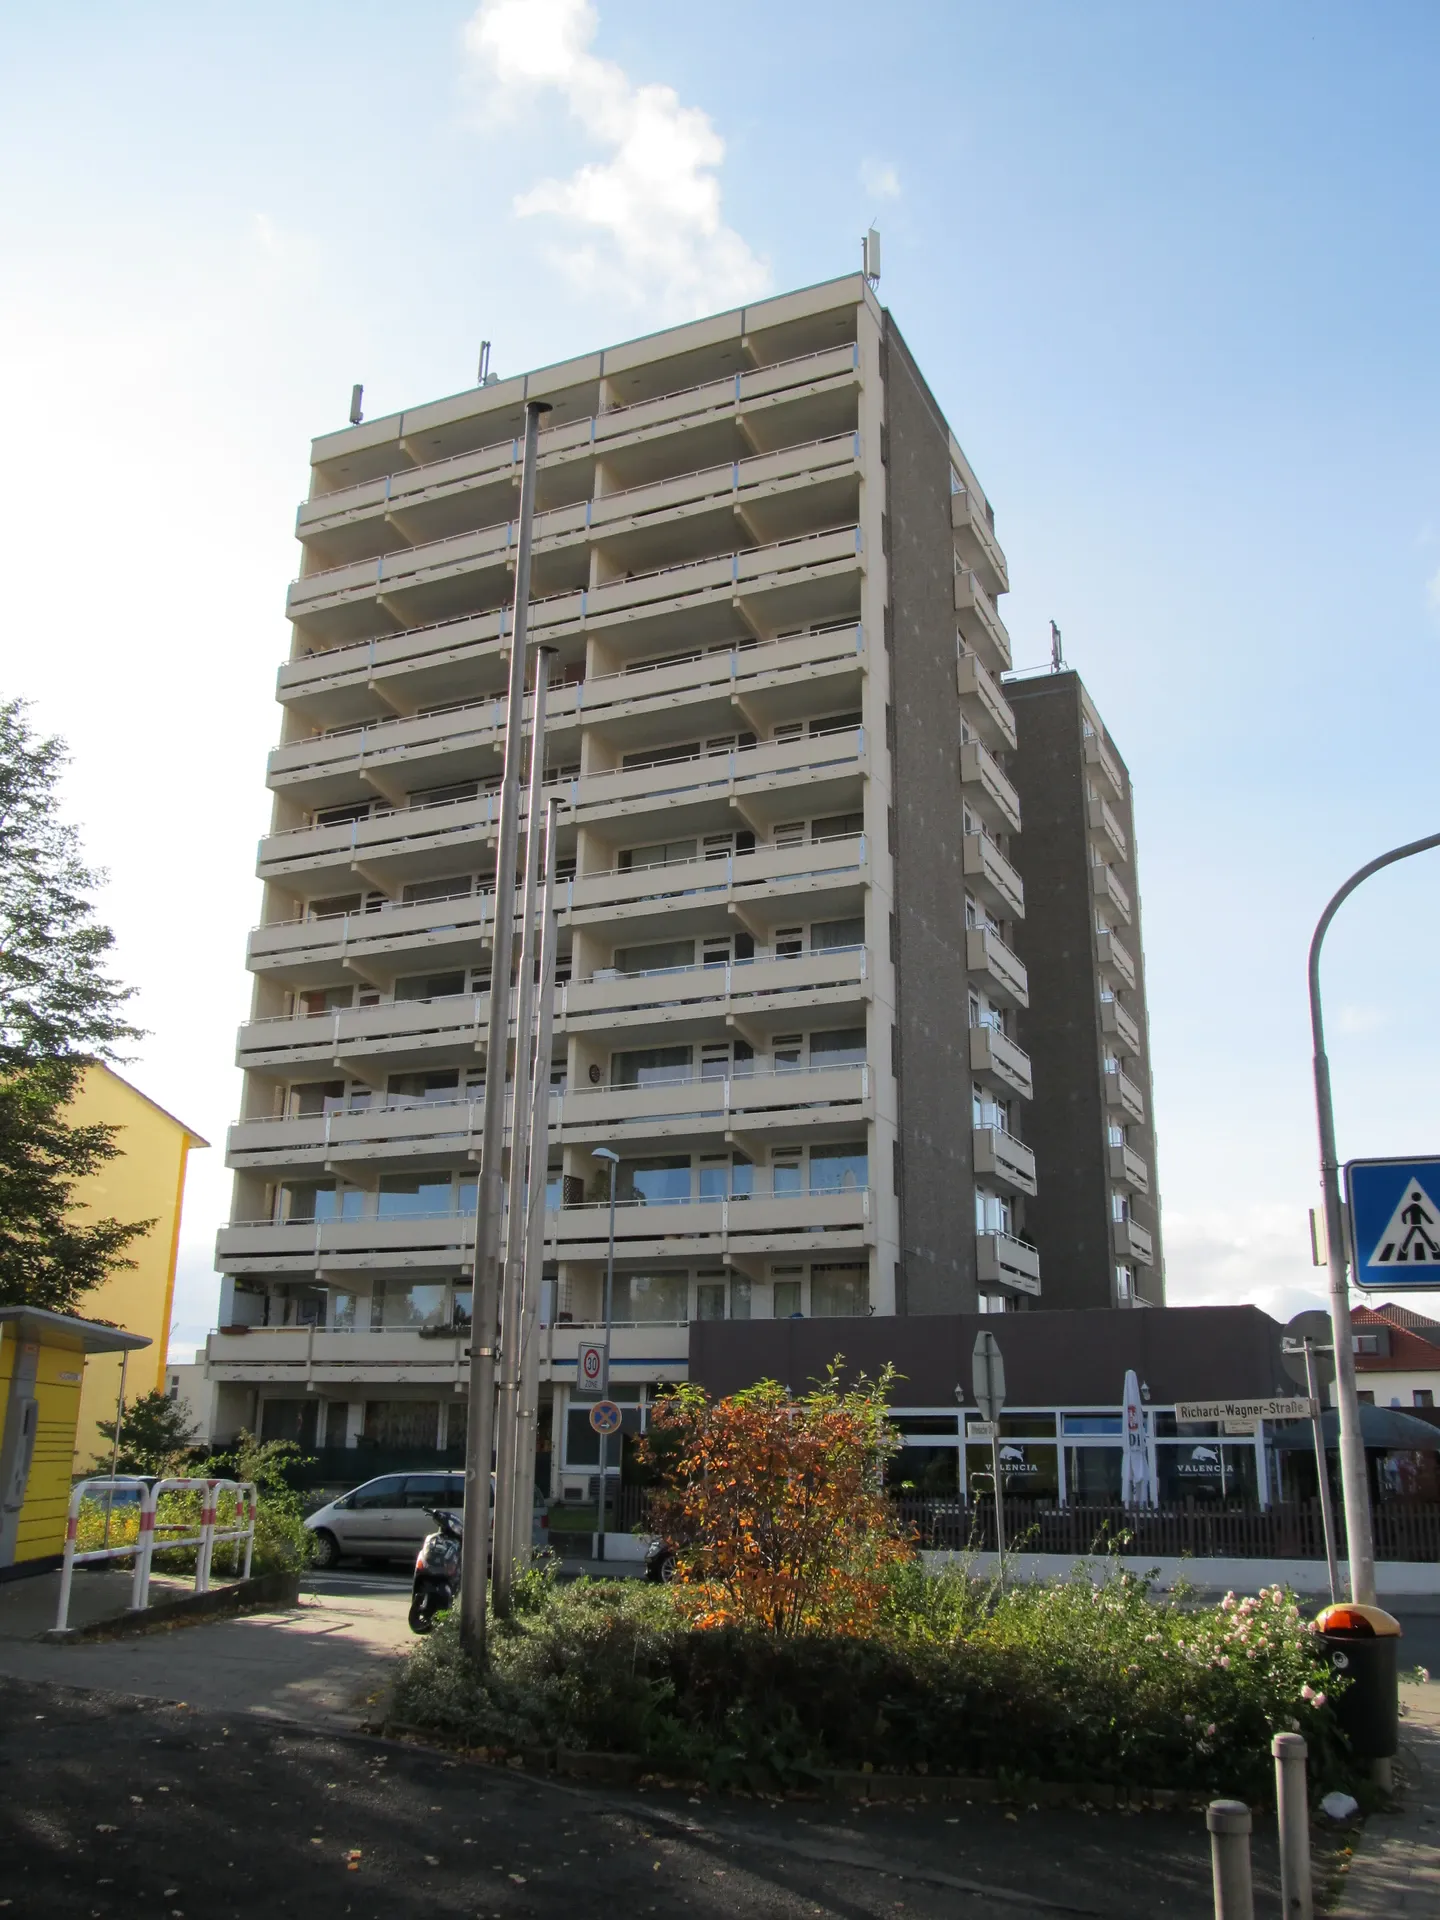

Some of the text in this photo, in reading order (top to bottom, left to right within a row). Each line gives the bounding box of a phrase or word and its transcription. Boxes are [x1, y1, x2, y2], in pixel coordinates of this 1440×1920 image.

[588, 1357, 597, 1370] 30
[585, 1380, 598, 1388] ZONE
[1181, 1401, 1304, 1418] Richard-Wagner-Straße
[985, 1463, 1038, 1472] VLENCIA
[1177, 1464, 1234, 1473] VALENCA
